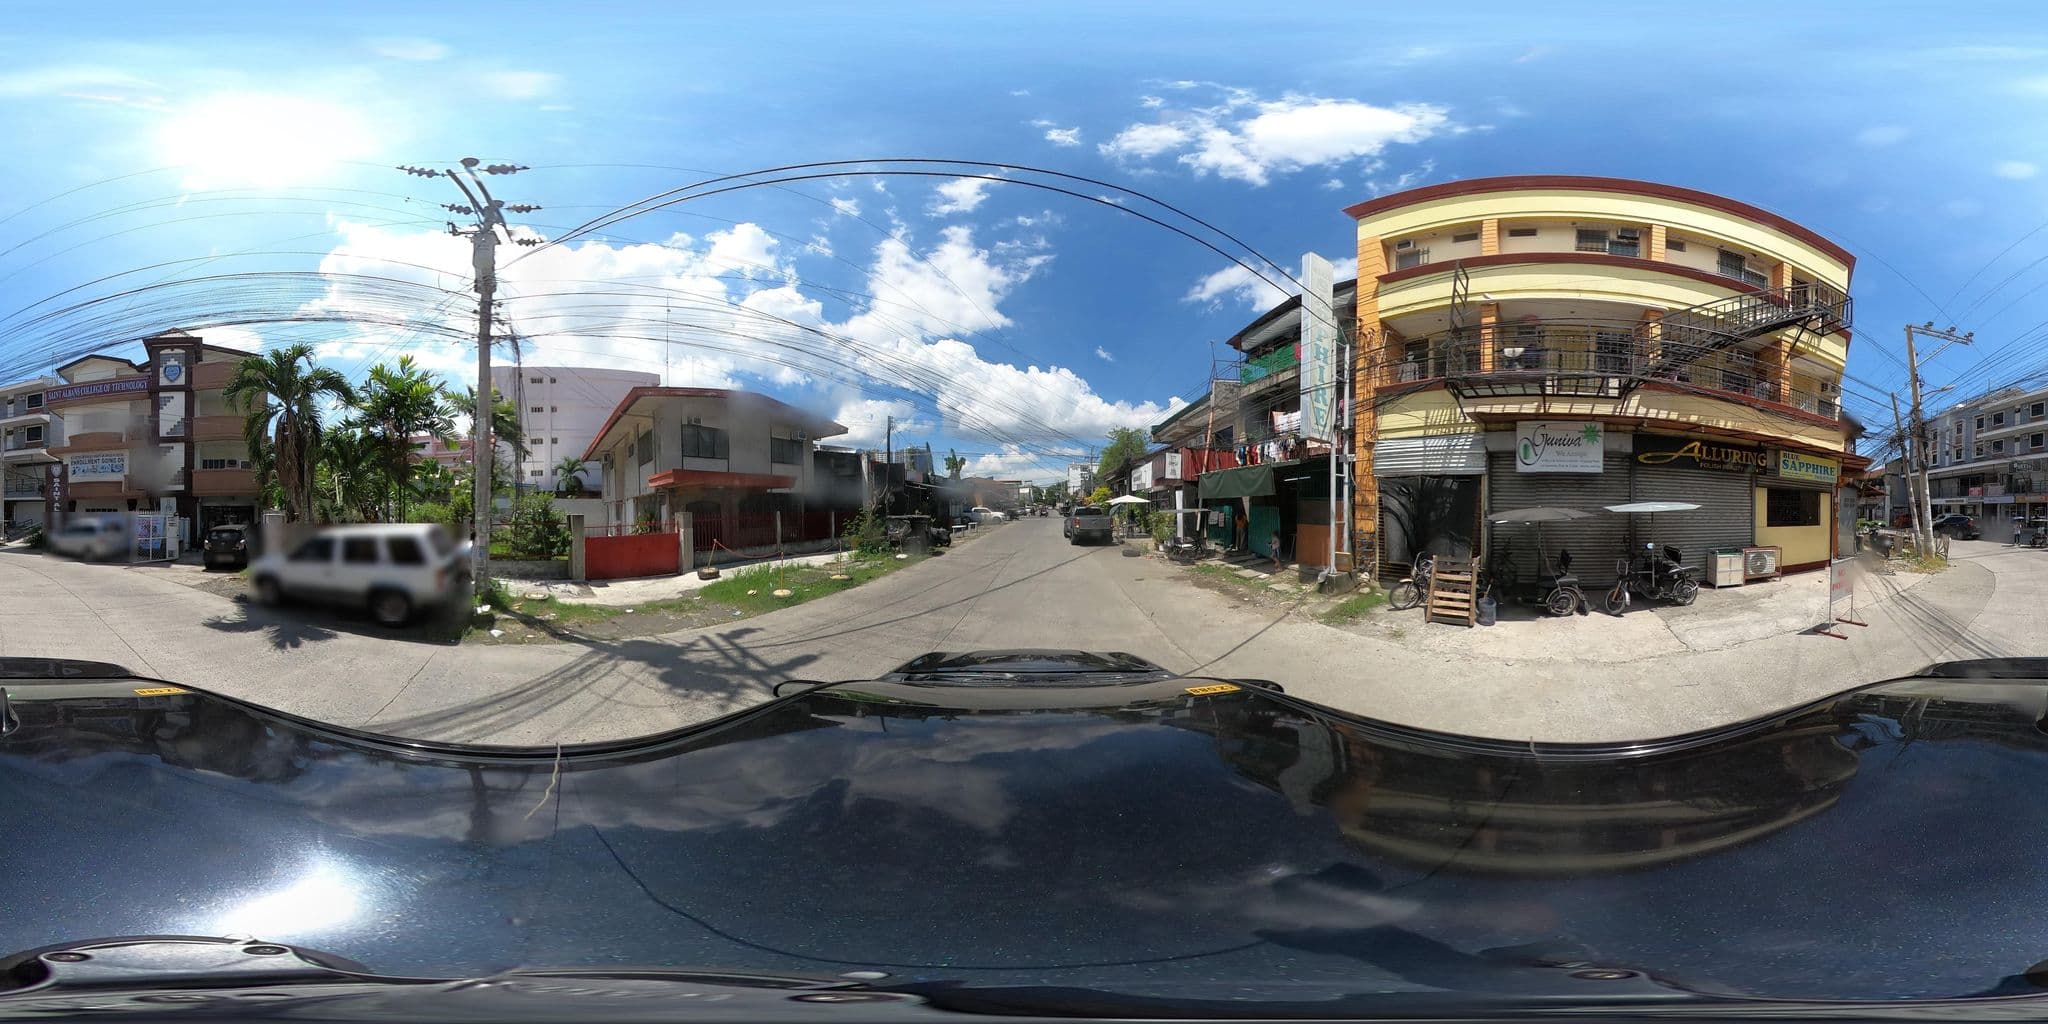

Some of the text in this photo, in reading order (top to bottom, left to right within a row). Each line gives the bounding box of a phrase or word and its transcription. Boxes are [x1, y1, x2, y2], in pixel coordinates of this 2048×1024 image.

[48, 381, 147, 400] SAINT ALBANS COLLEGE OF TECHNOLOGY
[1783, 452, 1799, 460] BLUE
[1782, 459, 1835, 476] SAPPHIRE
